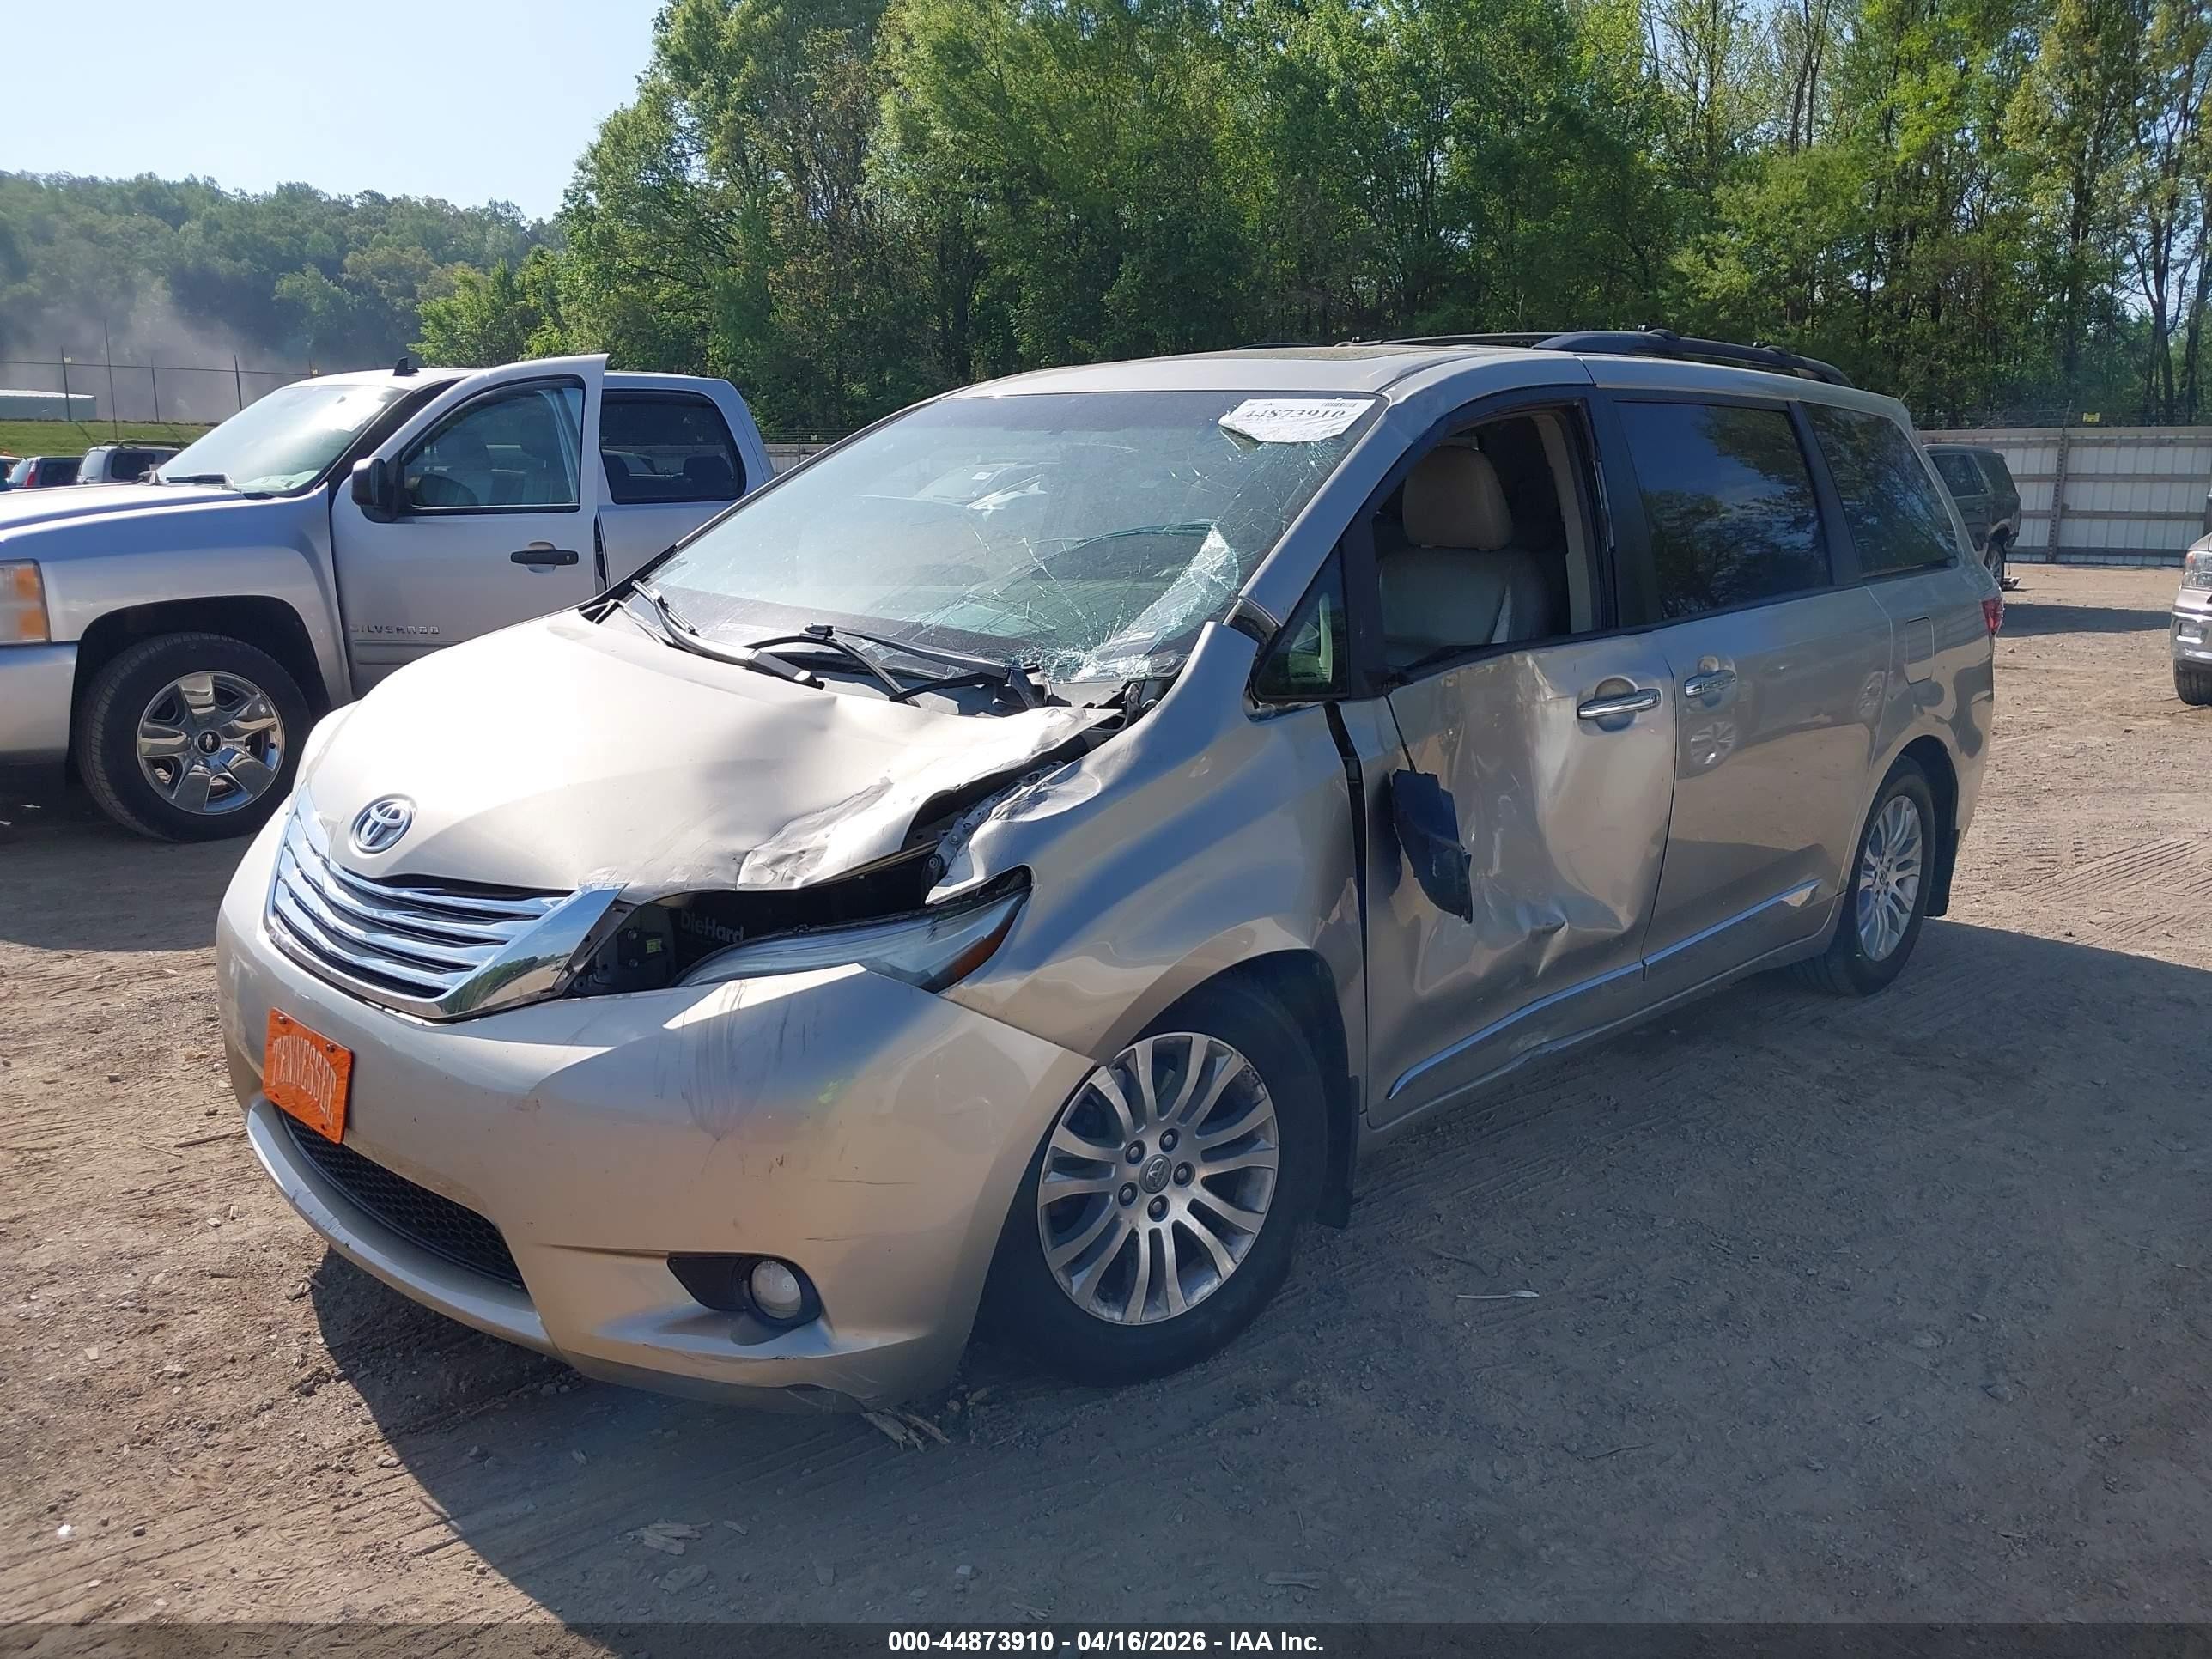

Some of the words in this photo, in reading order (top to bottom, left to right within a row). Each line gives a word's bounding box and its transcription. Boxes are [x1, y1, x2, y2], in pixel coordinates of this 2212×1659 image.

[1245, 409, 1346, 419] 44873910
[349, 624, 441, 635] SILVERADO
[679, 909, 746, 944] DieHard
[269, 1034, 338, 1128] TENNESSEE
